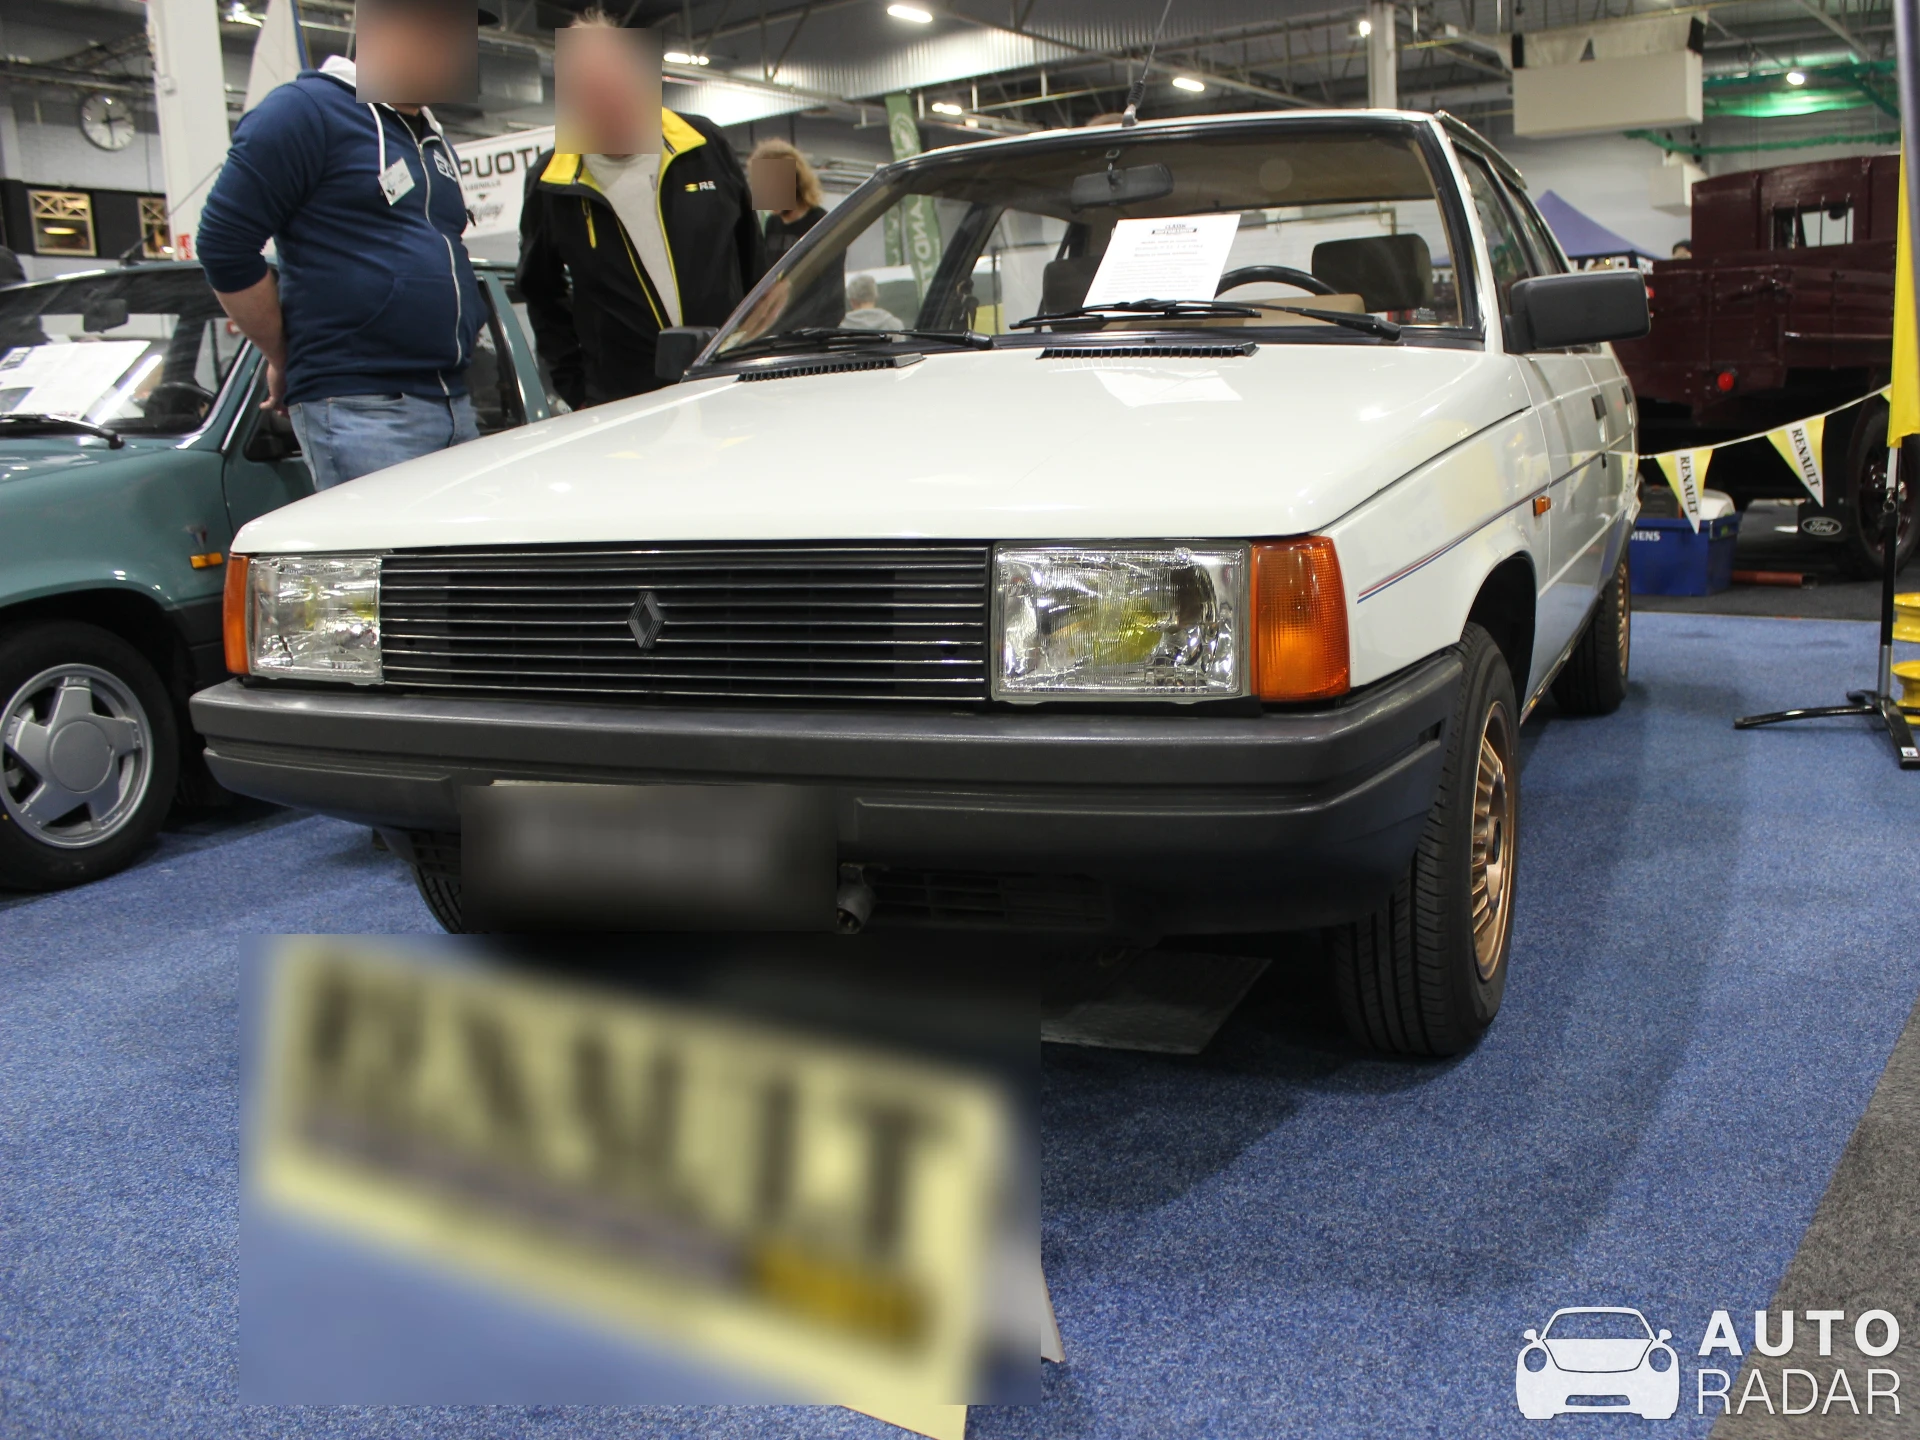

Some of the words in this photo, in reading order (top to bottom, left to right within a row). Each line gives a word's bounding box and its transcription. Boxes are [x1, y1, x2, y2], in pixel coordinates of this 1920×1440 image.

[1680, 456, 1699, 515] RENAULT
[1792, 428, 1821, 488] RENAULT
[1809, 520, 1834, 532] Ford
